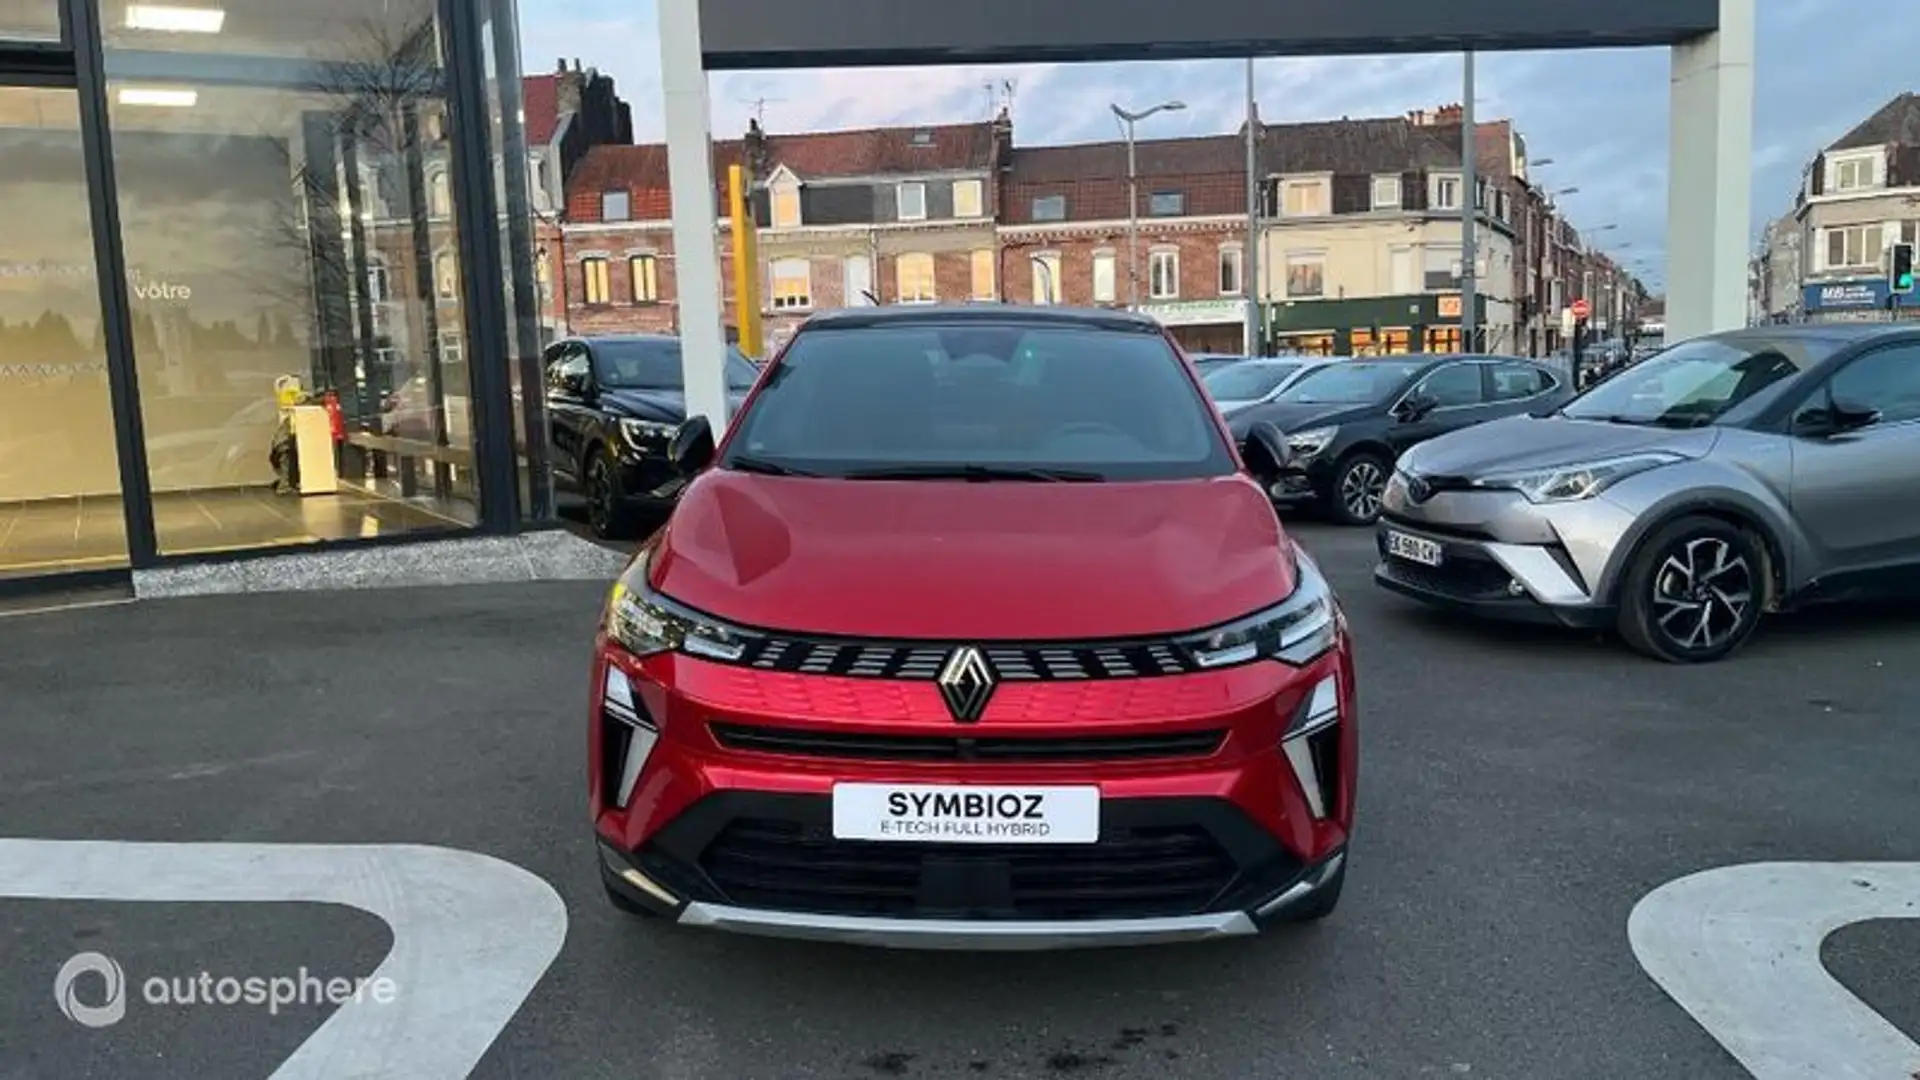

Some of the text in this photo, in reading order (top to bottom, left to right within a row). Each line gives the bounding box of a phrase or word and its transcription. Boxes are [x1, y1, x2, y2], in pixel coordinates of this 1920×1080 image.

[888, 792, 1044, 819] SYMBIOZ
[880, 820, 1050, 837] E-TECH FULL HYBRID
